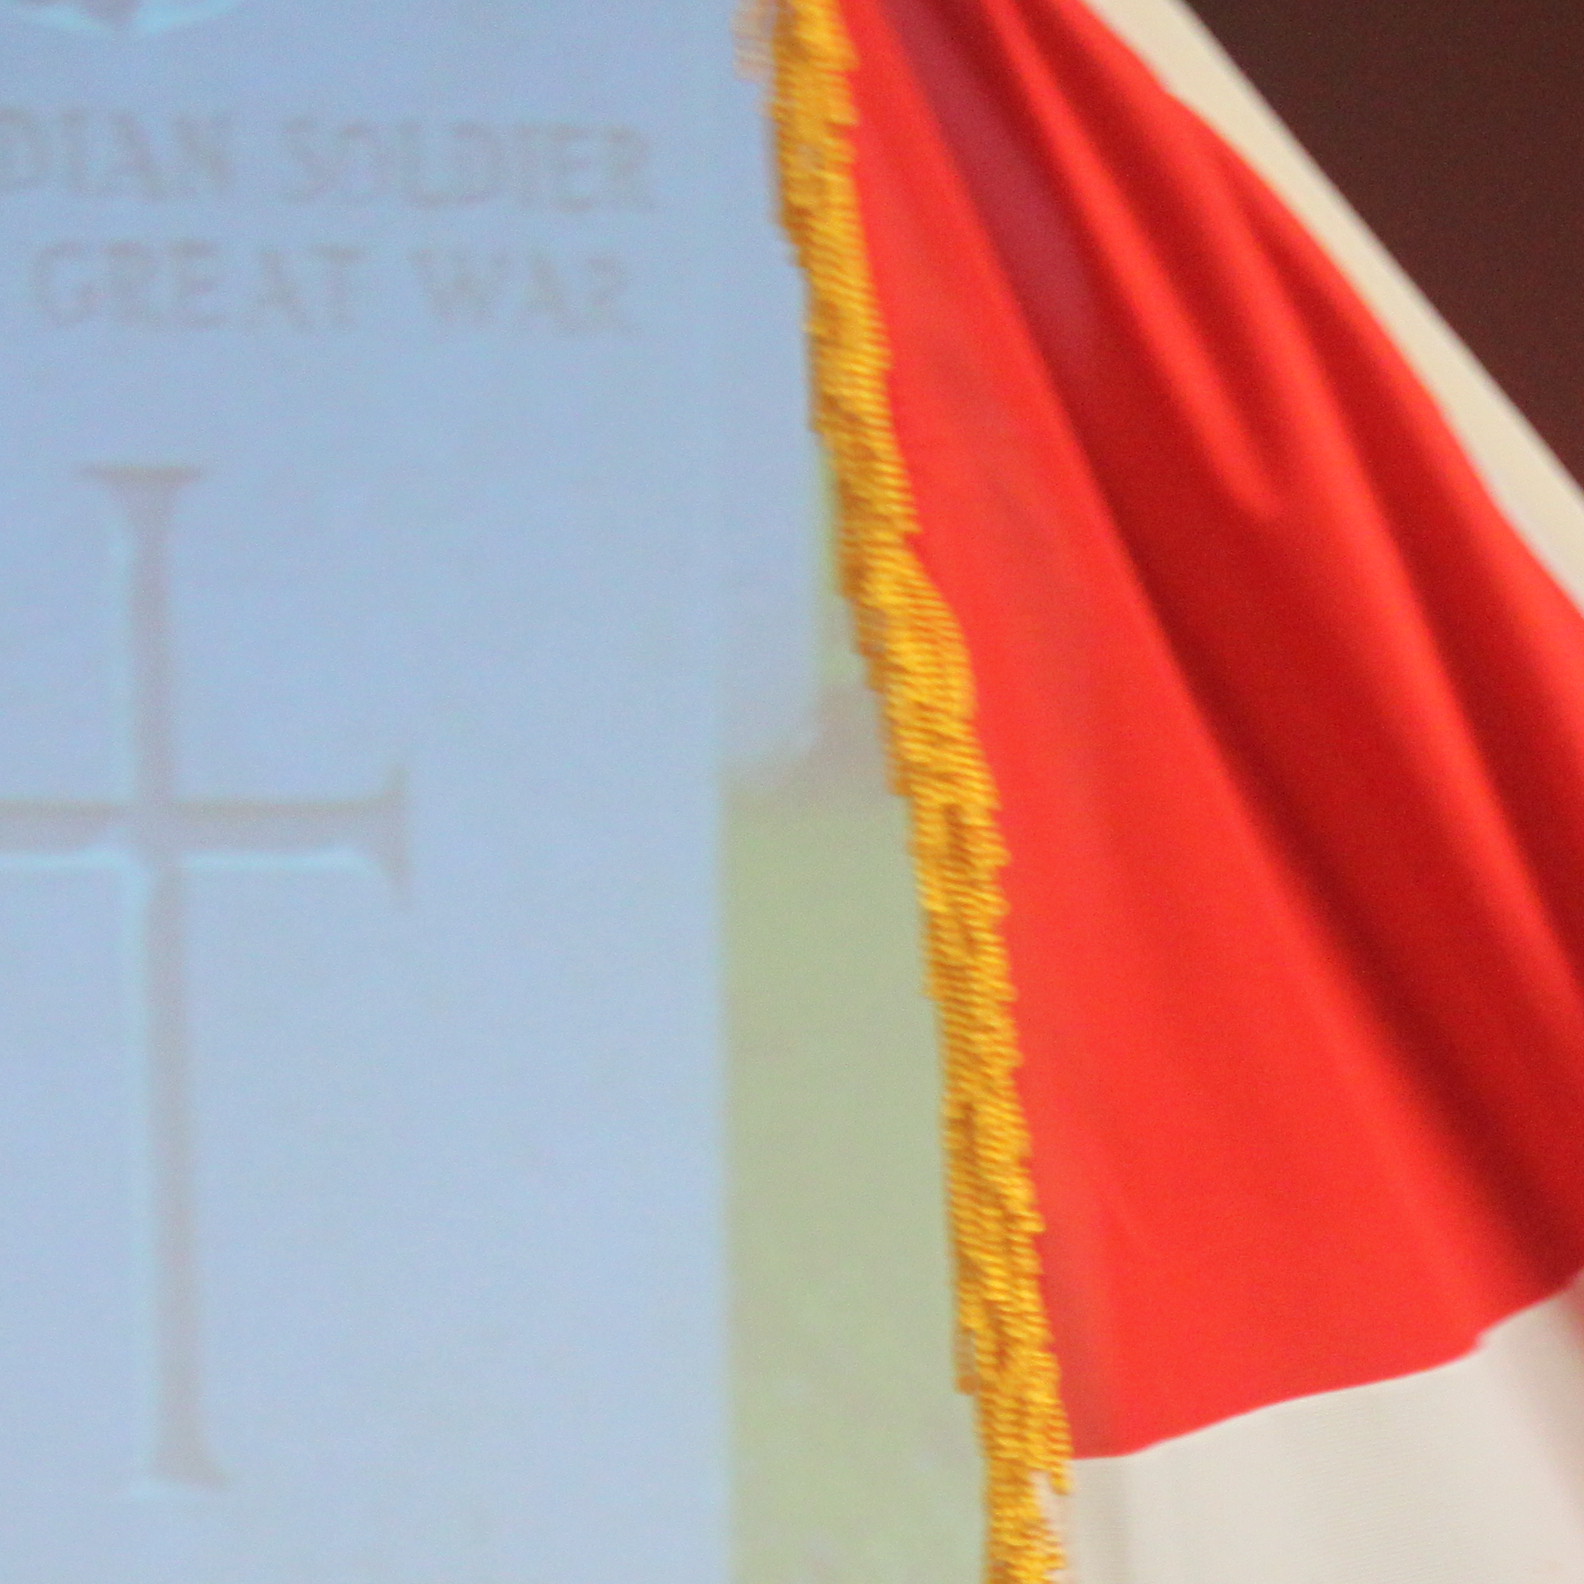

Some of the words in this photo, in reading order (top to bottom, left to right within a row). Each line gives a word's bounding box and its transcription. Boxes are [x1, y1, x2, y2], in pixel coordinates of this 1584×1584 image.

[278, 114, 658, 213] SOLDIER
[31, 239, 366, 335] GREAT
[408, 247, 641, 338] WAR
